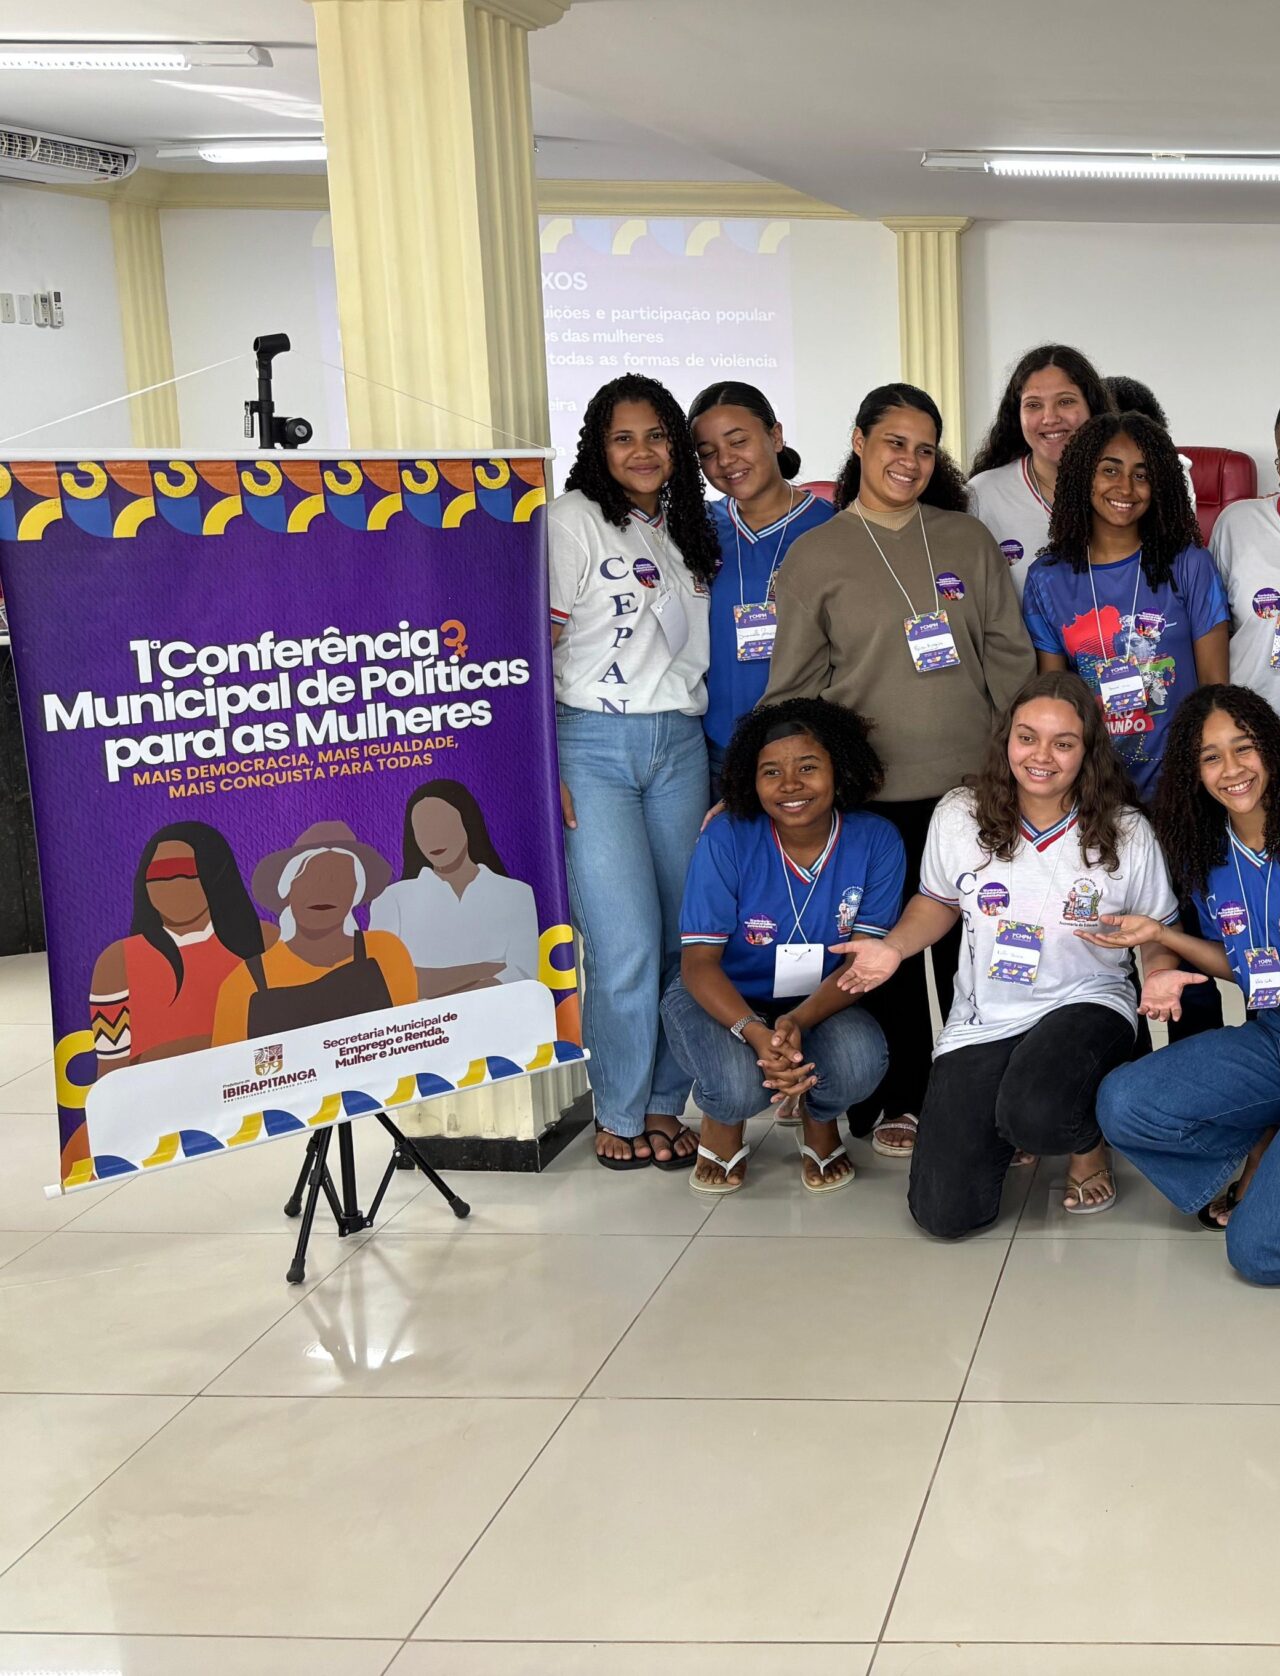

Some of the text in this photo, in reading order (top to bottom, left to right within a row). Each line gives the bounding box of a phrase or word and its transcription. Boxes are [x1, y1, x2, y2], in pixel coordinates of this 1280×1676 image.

[596, 308, 606, 319] e
[611, 306, 711, 324] participação
[716, 308, 776, 325] popular
[562, 328, 590, 343] das
[593, 328, 664, 343] mulheres
[549, 352, 778, 368] todas as formas de violência
[43, 655, 530, 731] Municipal de Políticas
[105, 699, 492, 782] para as Mulheres
[133, 735, 459, 786] MAIS DEMOCRACIA, MAIS IGUALDADE,
[168, 753, 433, 799] MAIS CONQUISTA PARA TODAS
[323, 1012, 458, 1049] Secretaria Municipal de
[339, 1027, 445, 1056] Emprego e Renda,
[335, 1035, 450, 1069] Mulher e Juventude
[222, 1068, 317, 1100] IBIRAPITANGA
